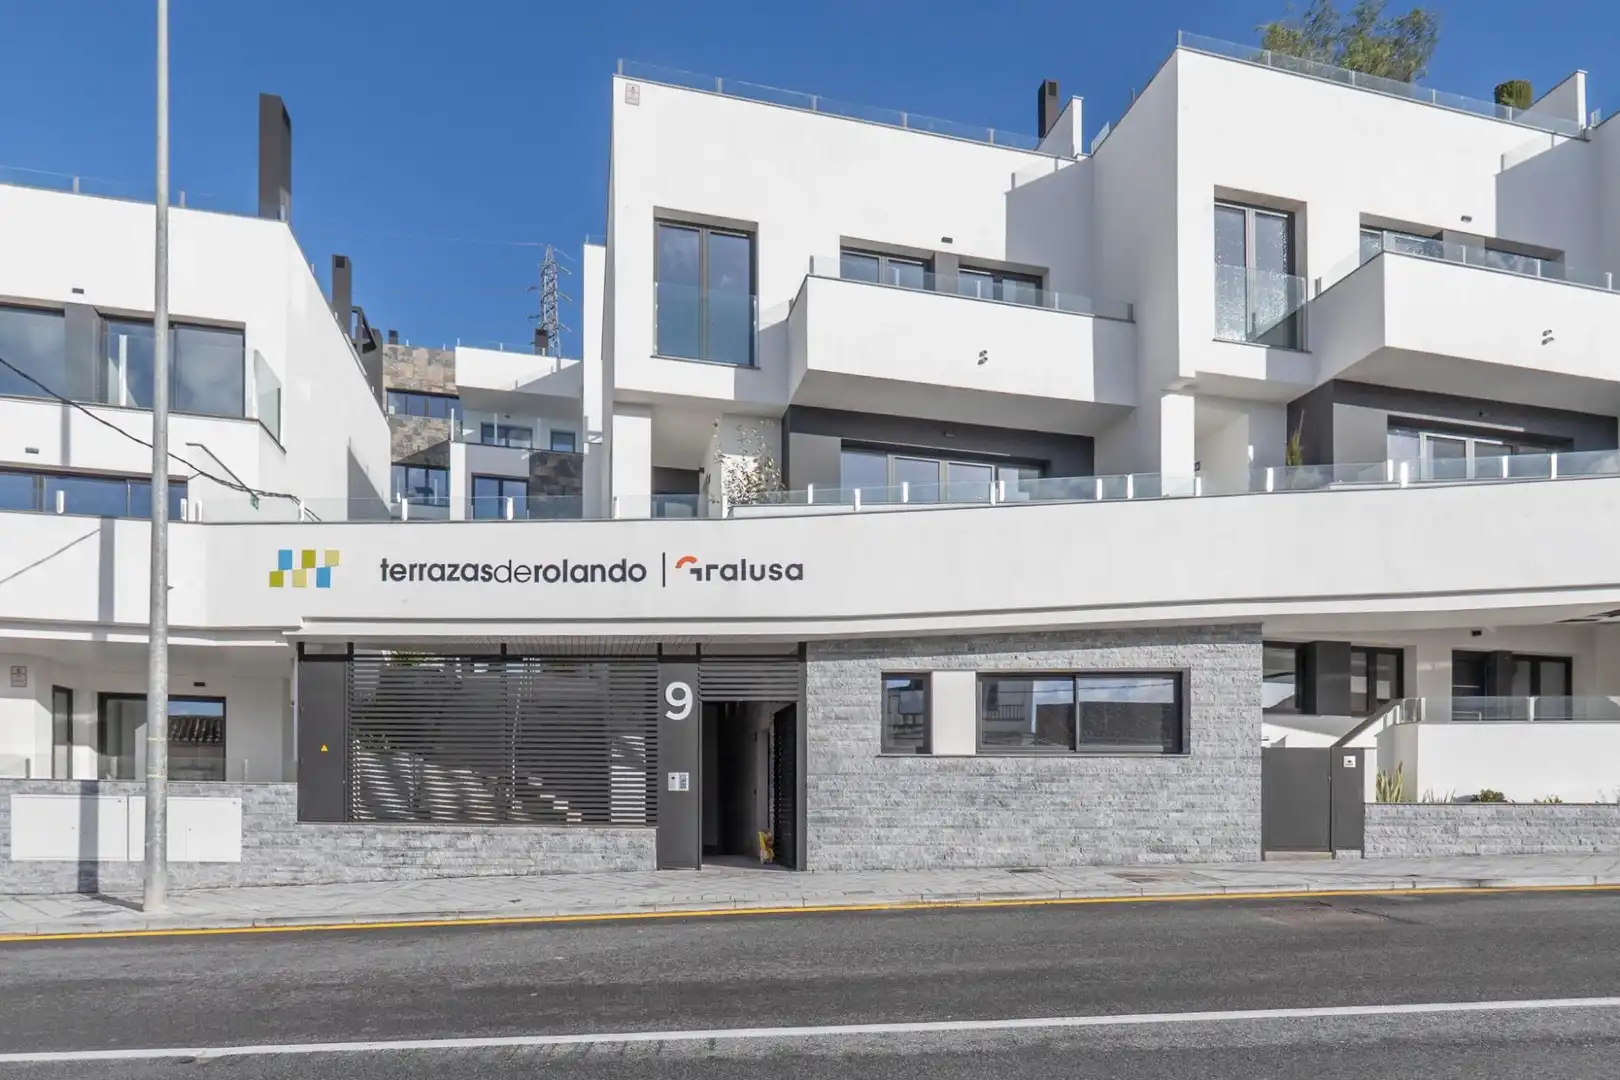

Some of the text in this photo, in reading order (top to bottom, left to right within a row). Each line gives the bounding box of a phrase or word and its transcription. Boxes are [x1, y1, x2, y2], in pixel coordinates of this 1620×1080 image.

[380, 555, 804, 584] terrazasderolando Gralusa
[665, 681, 693, 721] 9
